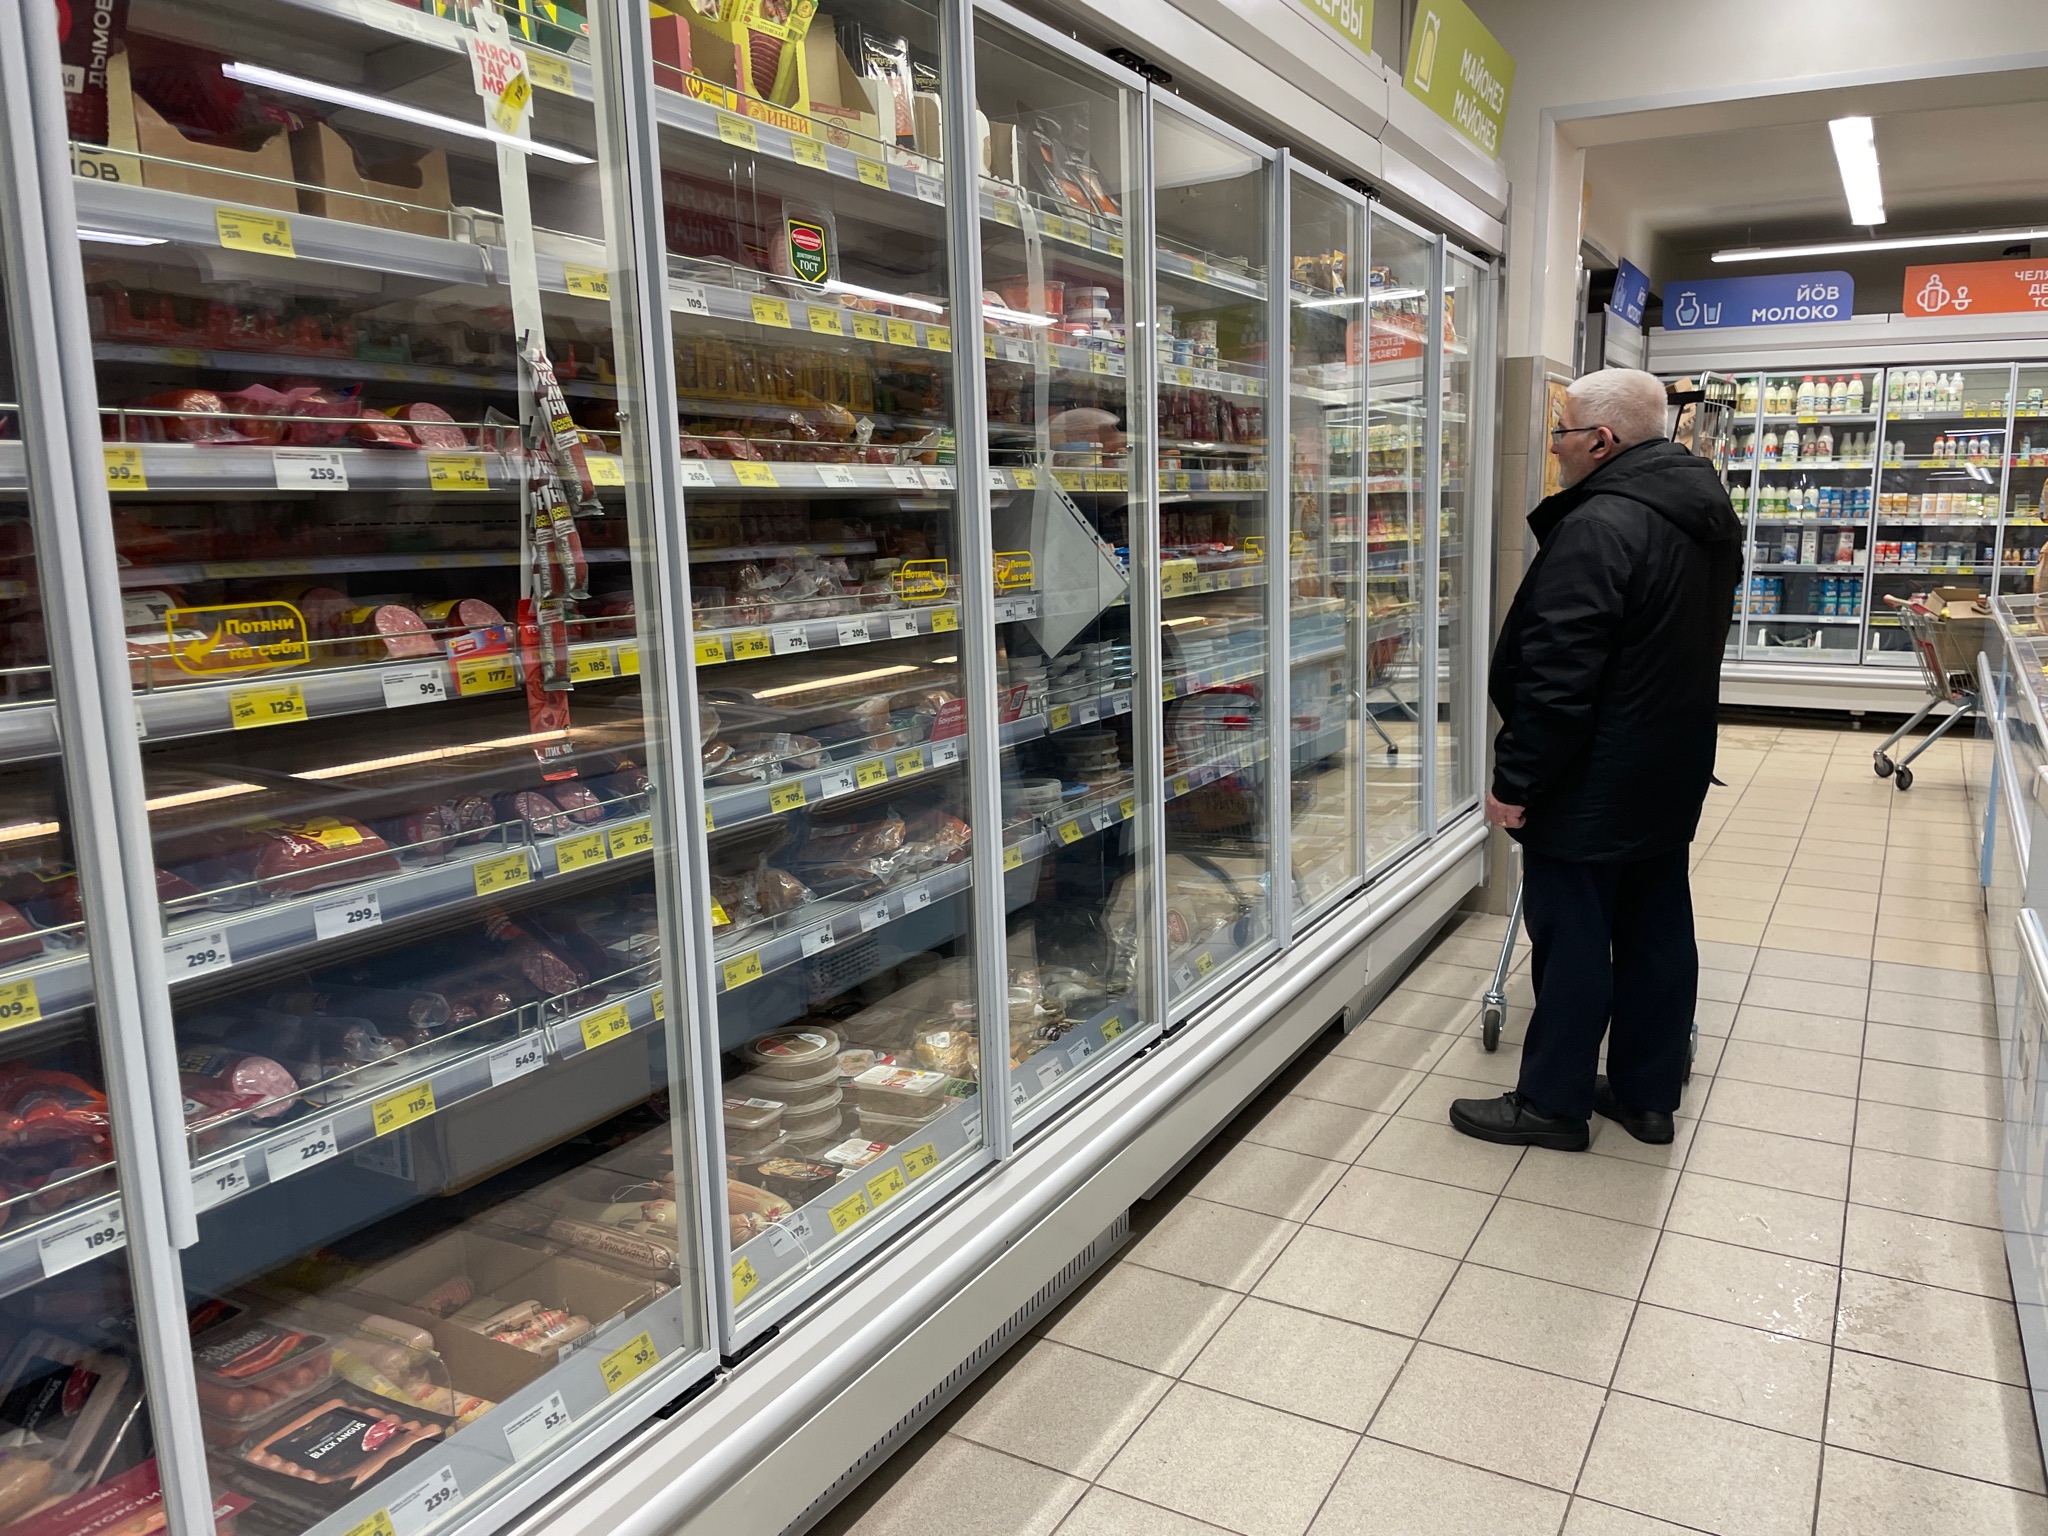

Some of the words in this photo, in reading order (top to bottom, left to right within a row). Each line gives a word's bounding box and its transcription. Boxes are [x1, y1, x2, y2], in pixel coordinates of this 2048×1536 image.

[474, 38, 522, 71] МЯСО
[477, 56, 508, 82] ТАК
[1459, 47, 1505, 115] МАЙОНЕЗ
[1452, 89, 1498, 152] МАЙОНЕЗ
[799, 260, 819, 273] ГОСТ
[686, 297, 702, 309] 109
[773, 311, 784, 321] 89
[1751, 304, 1839, 323] МОЛОКО
[108, 466, 130, 480] 99
[309, 467, 336, 481] 259
[458, 470, 479, 482] 164
[687, 472, 704, 482] 269
[904, 569, 932, 581] Потяни
[1182, 571, 1193, 584] 199
[905, 584, 915, 594] на
[916, 582, 933, 593] себя
[224, 617, 296, 637] Потяни
[852, 628, 864, 638] 209
[228, 648, 254, 661] на
[258, 638, 303, 658] себя
[749, 641, 765, 651] 269
[789, 637, 803, 648] 279
[704, 647, 719, 658] 139
[588, 661, 606, 673] 189
[487, 670, 506, 684] 177
[419, 682, 436, 695] 99
[269, 700, 294, 716] 129
[839, 778, 850, 788] 79
[785, 793, 801, 804] 709
[633, 833, 649, 845] 219
[582, 847, 600, 860] 105
[503, 867, 522, 881] 219
[346, 908, 372, 924] 299
[876, 909, 886, 920] 89
[185, 950, 217, 968] 299
[608, 1017, 626, 1033] 189
[515, 1051, 537, 1069] 549
[407, 1098, 426, 1114] 119
[300, 1140, 327, 1161] 229
[216, 1172, 237, 1191] 75
[855, 1203, 867, 1217] 79
[85, 1226, 116, 1250] 189
[742, 1273, 754, 1289] 39
[634, 1349, 649, 1366] 39
[544, 1411, 561, 1430] 53
[309, 1440, 340, 1460] BLACK
[336, 1421, 368, 1444] ANGUS
[424, 1486, 451, 1513] 239
